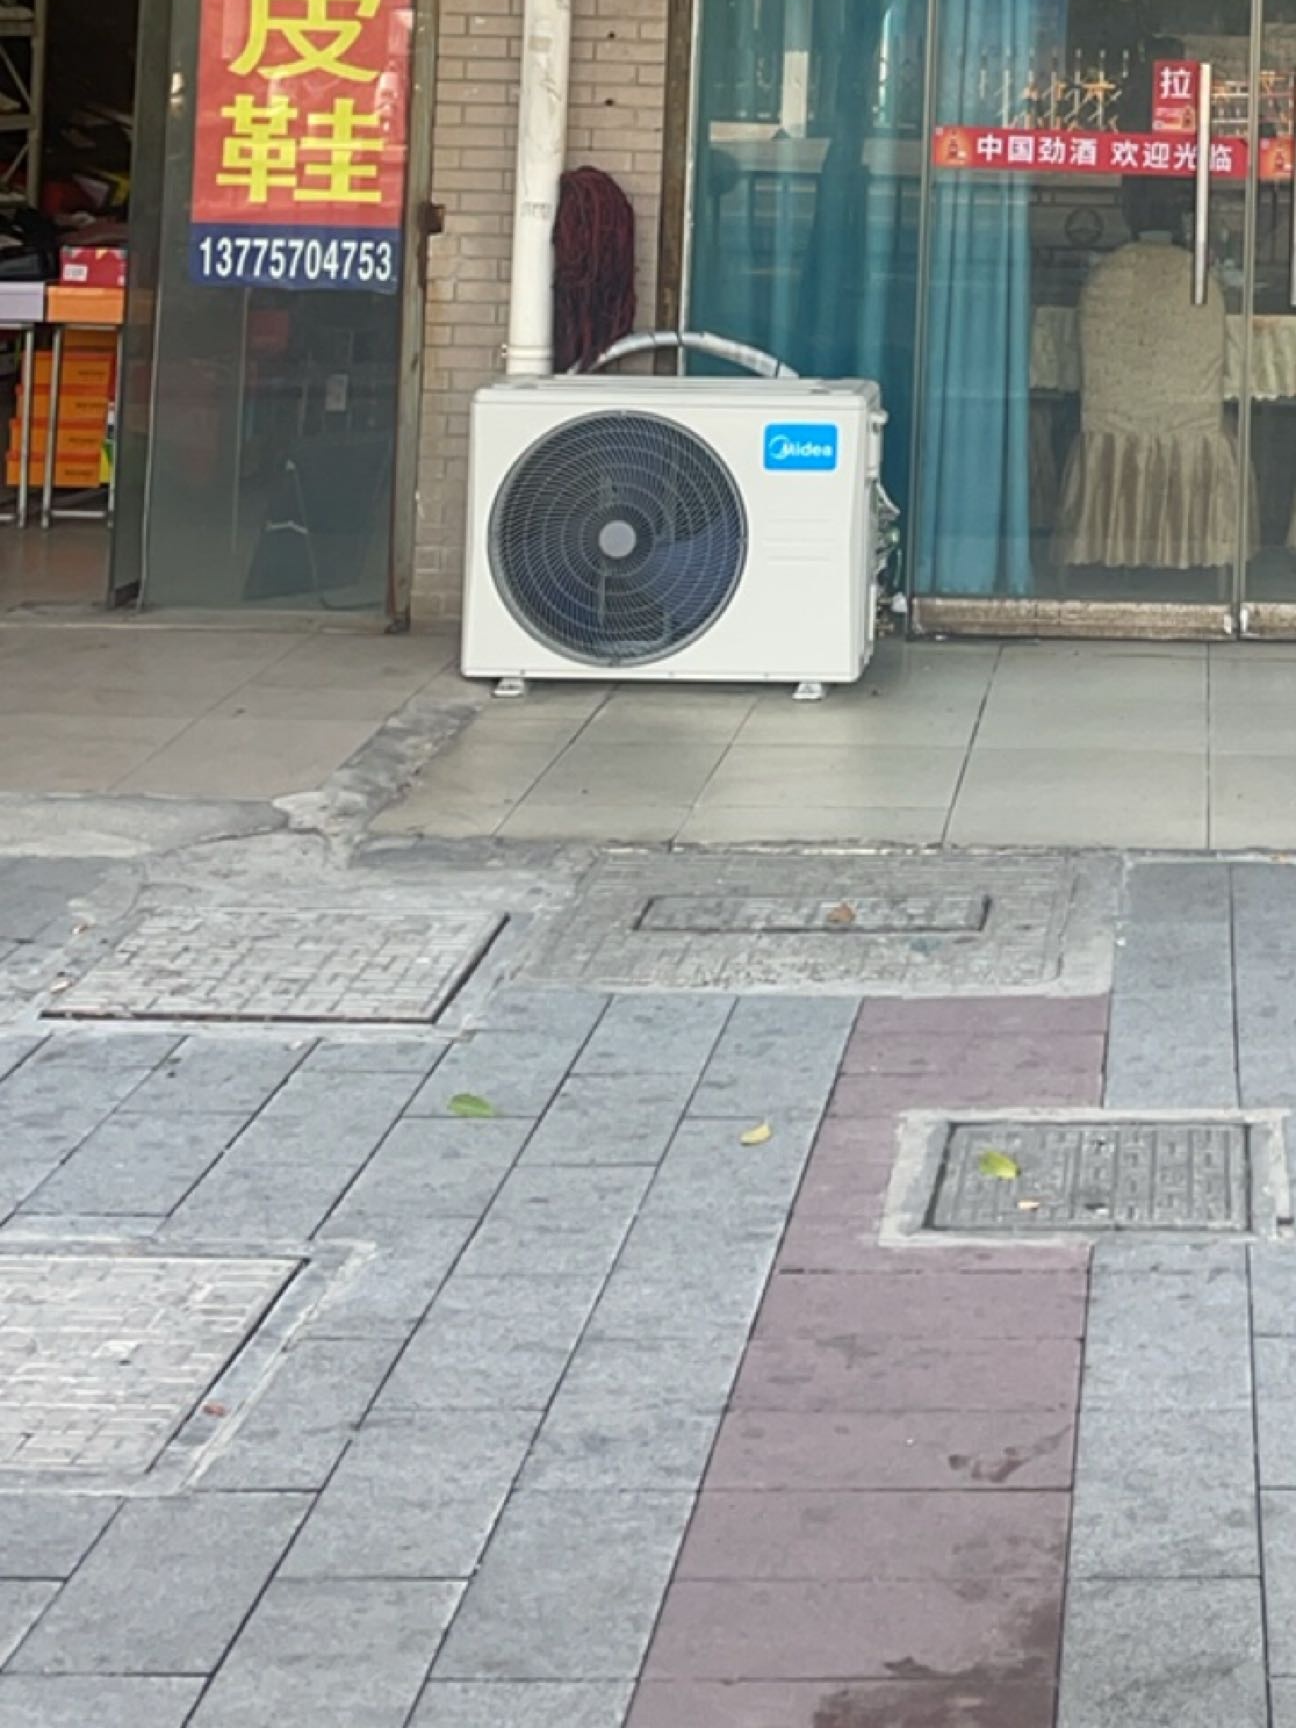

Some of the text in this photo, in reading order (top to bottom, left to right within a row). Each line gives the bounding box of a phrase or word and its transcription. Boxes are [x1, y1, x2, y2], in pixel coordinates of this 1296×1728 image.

[1160, 66, 1192, 100] 拉
[976, 133, 1232, 172] 中国劲酒 欢迎光临
[199, 237, 394, 282] 13775704753
[774, 437, 833, 459] Midea
